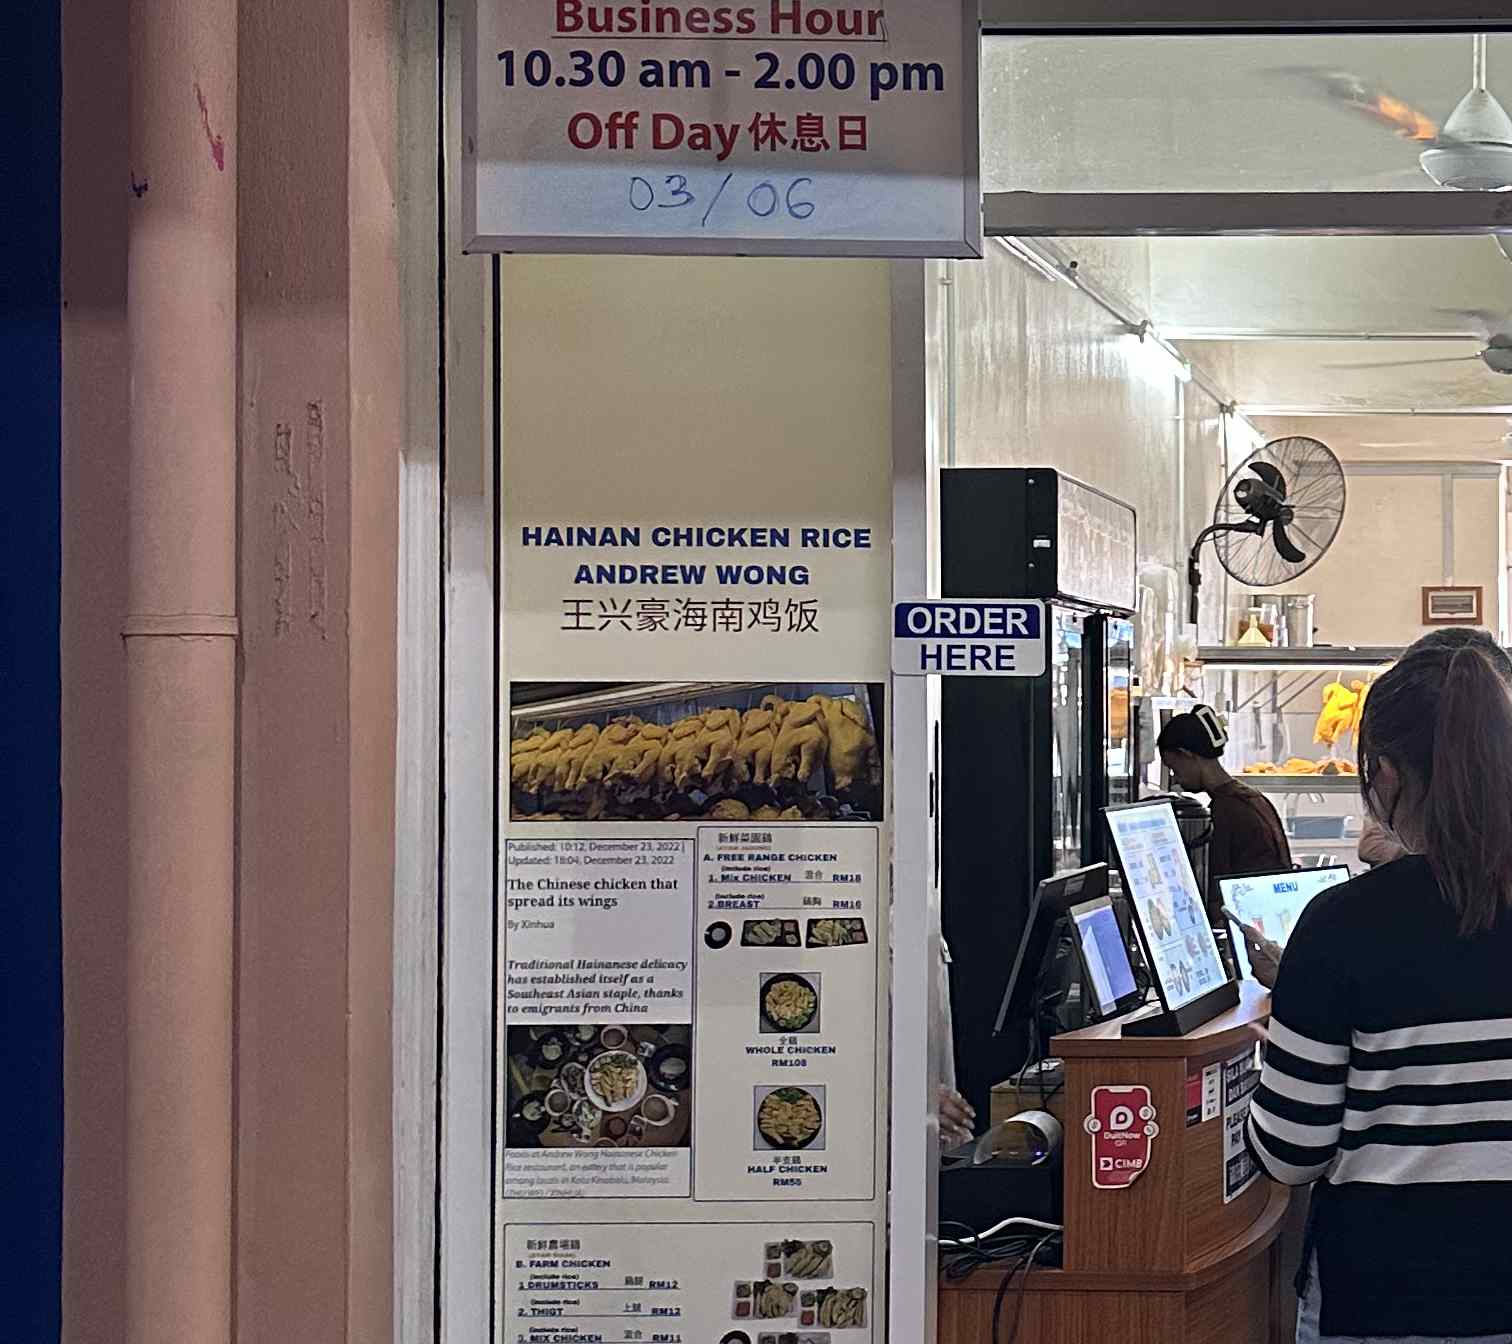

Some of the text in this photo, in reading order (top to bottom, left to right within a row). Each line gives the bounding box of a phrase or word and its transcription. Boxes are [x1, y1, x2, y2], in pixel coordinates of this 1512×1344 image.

[770, 0, 885, 36] Hour
[498, 50, 626, 88] 10.30
[639, 59, 710, 89] am
[755, 53, 854, 90] 2.00
[870, 58, 944, 101] pm
[567, 112, 867, 160] Off Day 休息日
[522, 527, 872, 549] HAINAN CHICKEN RICE
[574, 564, 810, 585] ANDREW WONG
[560, 597, 820, 633] 王兴豪海南鸡饭
[907, 607, 1029, 635] ORDER
[920, 644, 1016, 671] HERE
[788, 854, 838, 862] CHICKEN
[508, 878, 678, 890] The Chinese chicken that
[743, 874, 792, 882] CHICKEN
[1272, 881, 1299, 893] MENU
[507, 896, 618, 910] spread its wings
[508, 960, 574, 970] Traditional
[567, 989, 600, 999] Asian
[614, 1003, 649, 1013] China
[746, 1046, 836, 1054] WHOLE CHICKEN
[747, 1165, 828, 1173] HALF CHICKEN
[1115, 1159, 1143, 1169] CIMB
[529, 1260, 559, 1268] FARM
[561, 1260, 611, 1268] CHICKEN
[553, 1335, 602, 1343] CHICKEN
